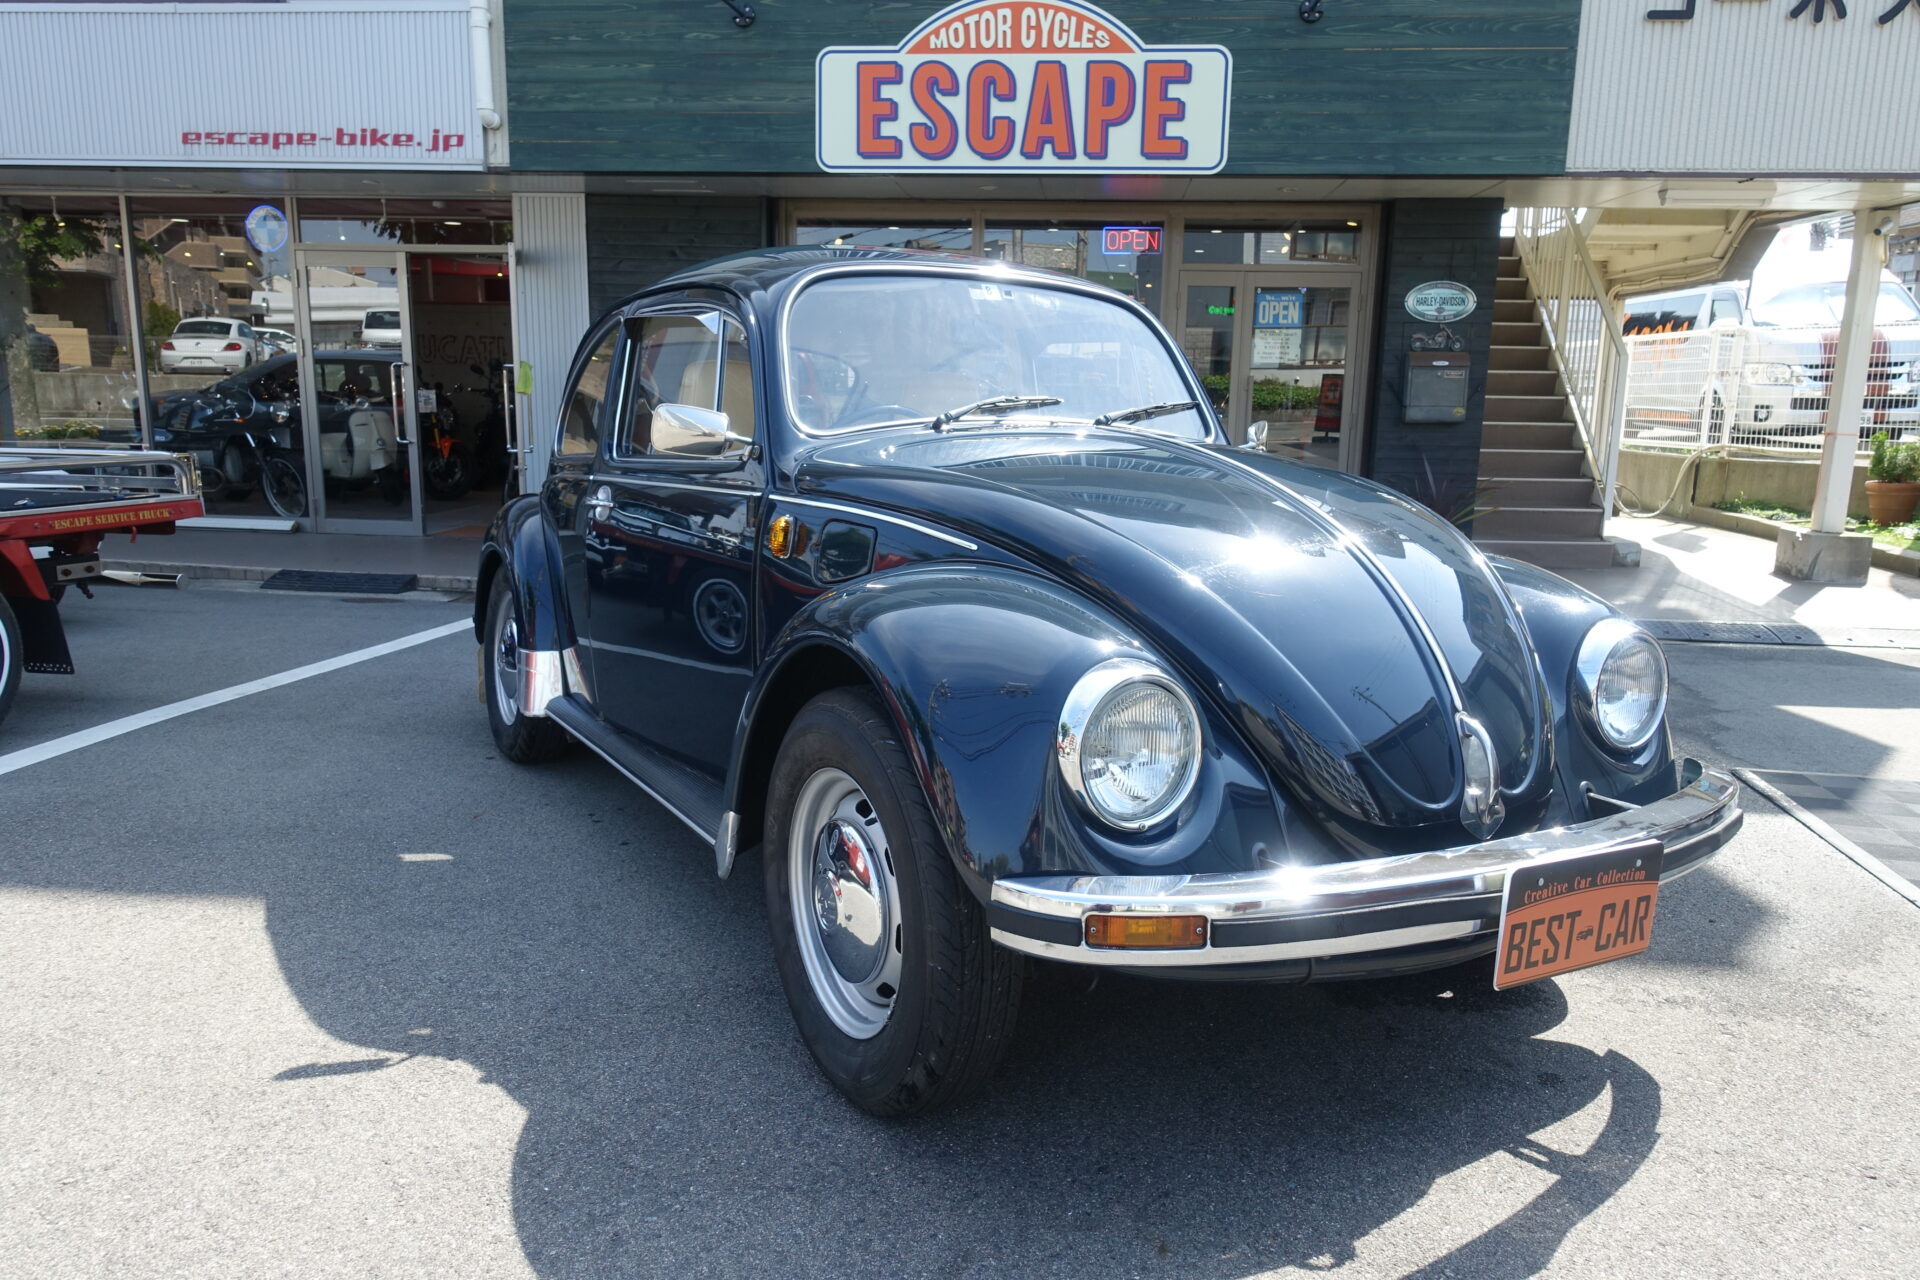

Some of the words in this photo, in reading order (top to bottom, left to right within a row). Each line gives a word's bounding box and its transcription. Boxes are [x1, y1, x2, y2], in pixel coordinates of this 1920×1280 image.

[929, 7, 1013, 50] MOTOR
[1020, 7, 1111, 49] CYCLES
[856, 59, 1193, 161] ESCAPE
[181, 127, 465, 153] escape-bike.jp
[1106, 230, 1160, 250] OPEN
[1258, 301, 1300, 324] OPEN
[1415, 296, 1467, 307] HARLEY-DAVIDSON
[416, 334, 509, 365] UCATI
[54, 517, 94, 530] ESCAPE
[95, 511, 137, 525] SERVICE
[137, 508, 170, 521] TRUCK
[1524, 881, 1569, 904] Creative
[1574, 876, 1592, 889] Car
[1597, 868, 1646, 885] Collection
[1503, 909, 1583, 975] BEST
[1594, 895, 1651, 952] CAR
